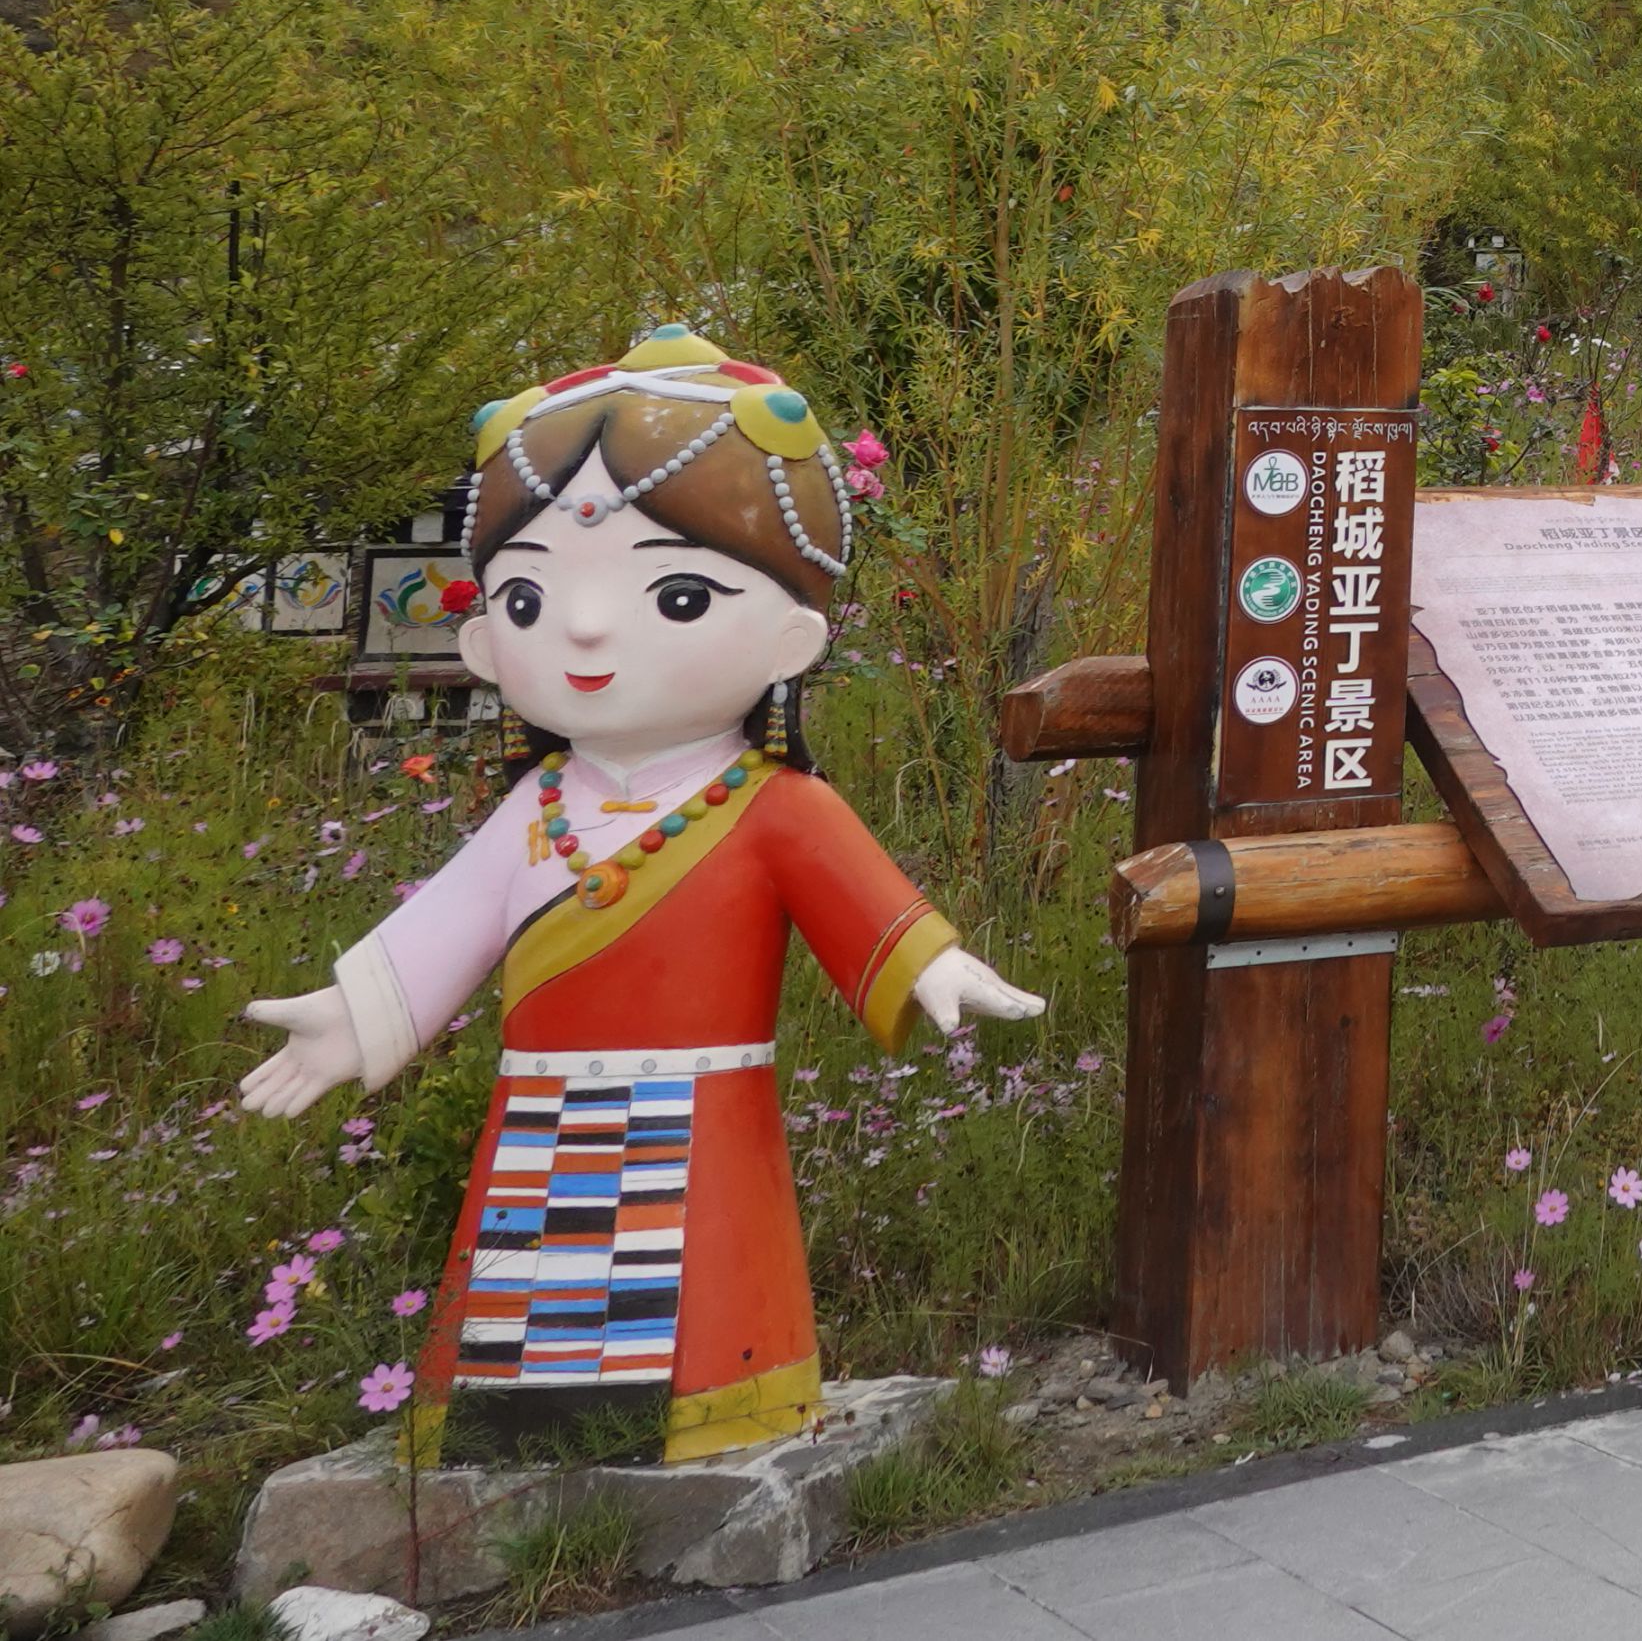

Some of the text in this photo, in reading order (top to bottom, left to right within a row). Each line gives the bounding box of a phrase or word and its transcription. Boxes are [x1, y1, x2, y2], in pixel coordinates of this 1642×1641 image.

[1296, 452, 1327, 790] DAOCHENG YADING SCENIC AREA
[1324, 450, 1386, 790] 稻城亚丁景区
[1504, 541, 1573, 551] Daocheng
[1575, 540, 1620, 550] Yading
